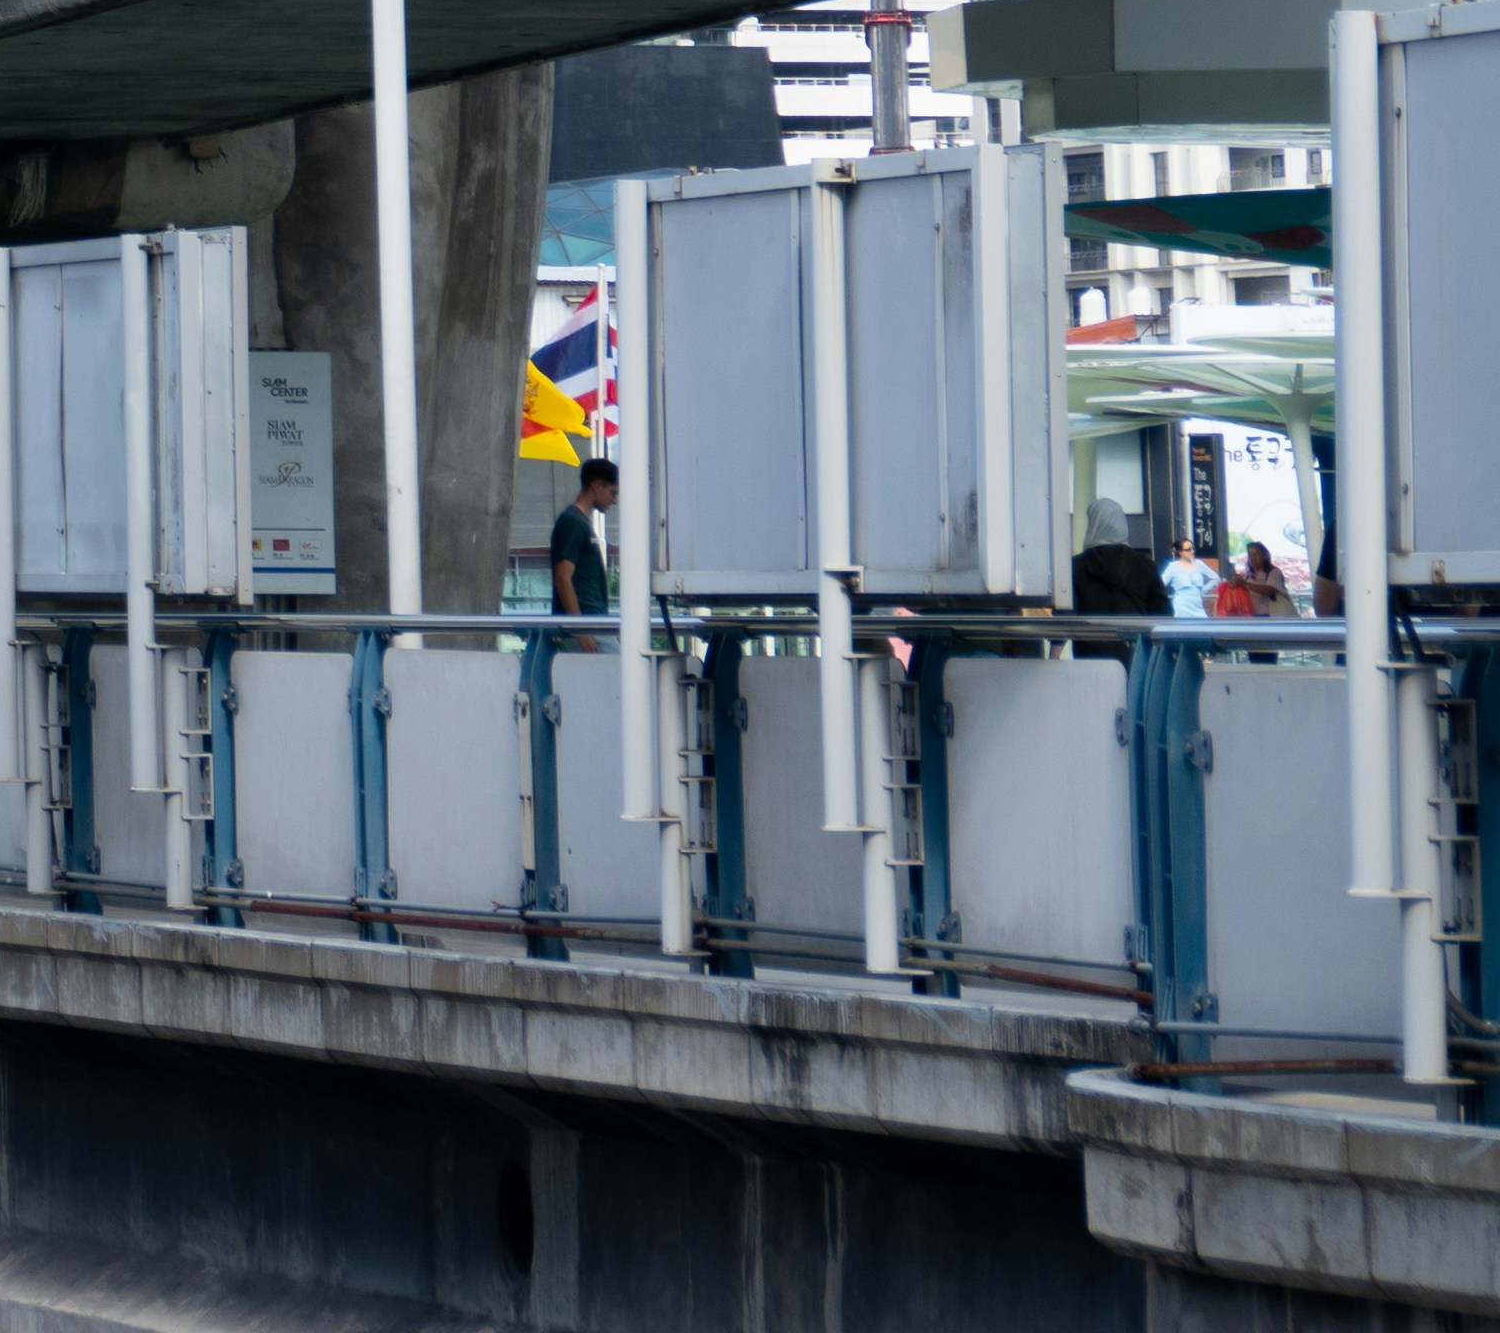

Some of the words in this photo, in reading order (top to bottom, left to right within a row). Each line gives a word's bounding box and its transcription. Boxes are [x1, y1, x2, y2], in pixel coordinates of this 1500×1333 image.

[262, 377, 288, 388] SIAM
[270, 387, 308, 397] CENTER
[267, 420, 296, 430] SIAM
[267, 430, 304, 440] PIWAT
